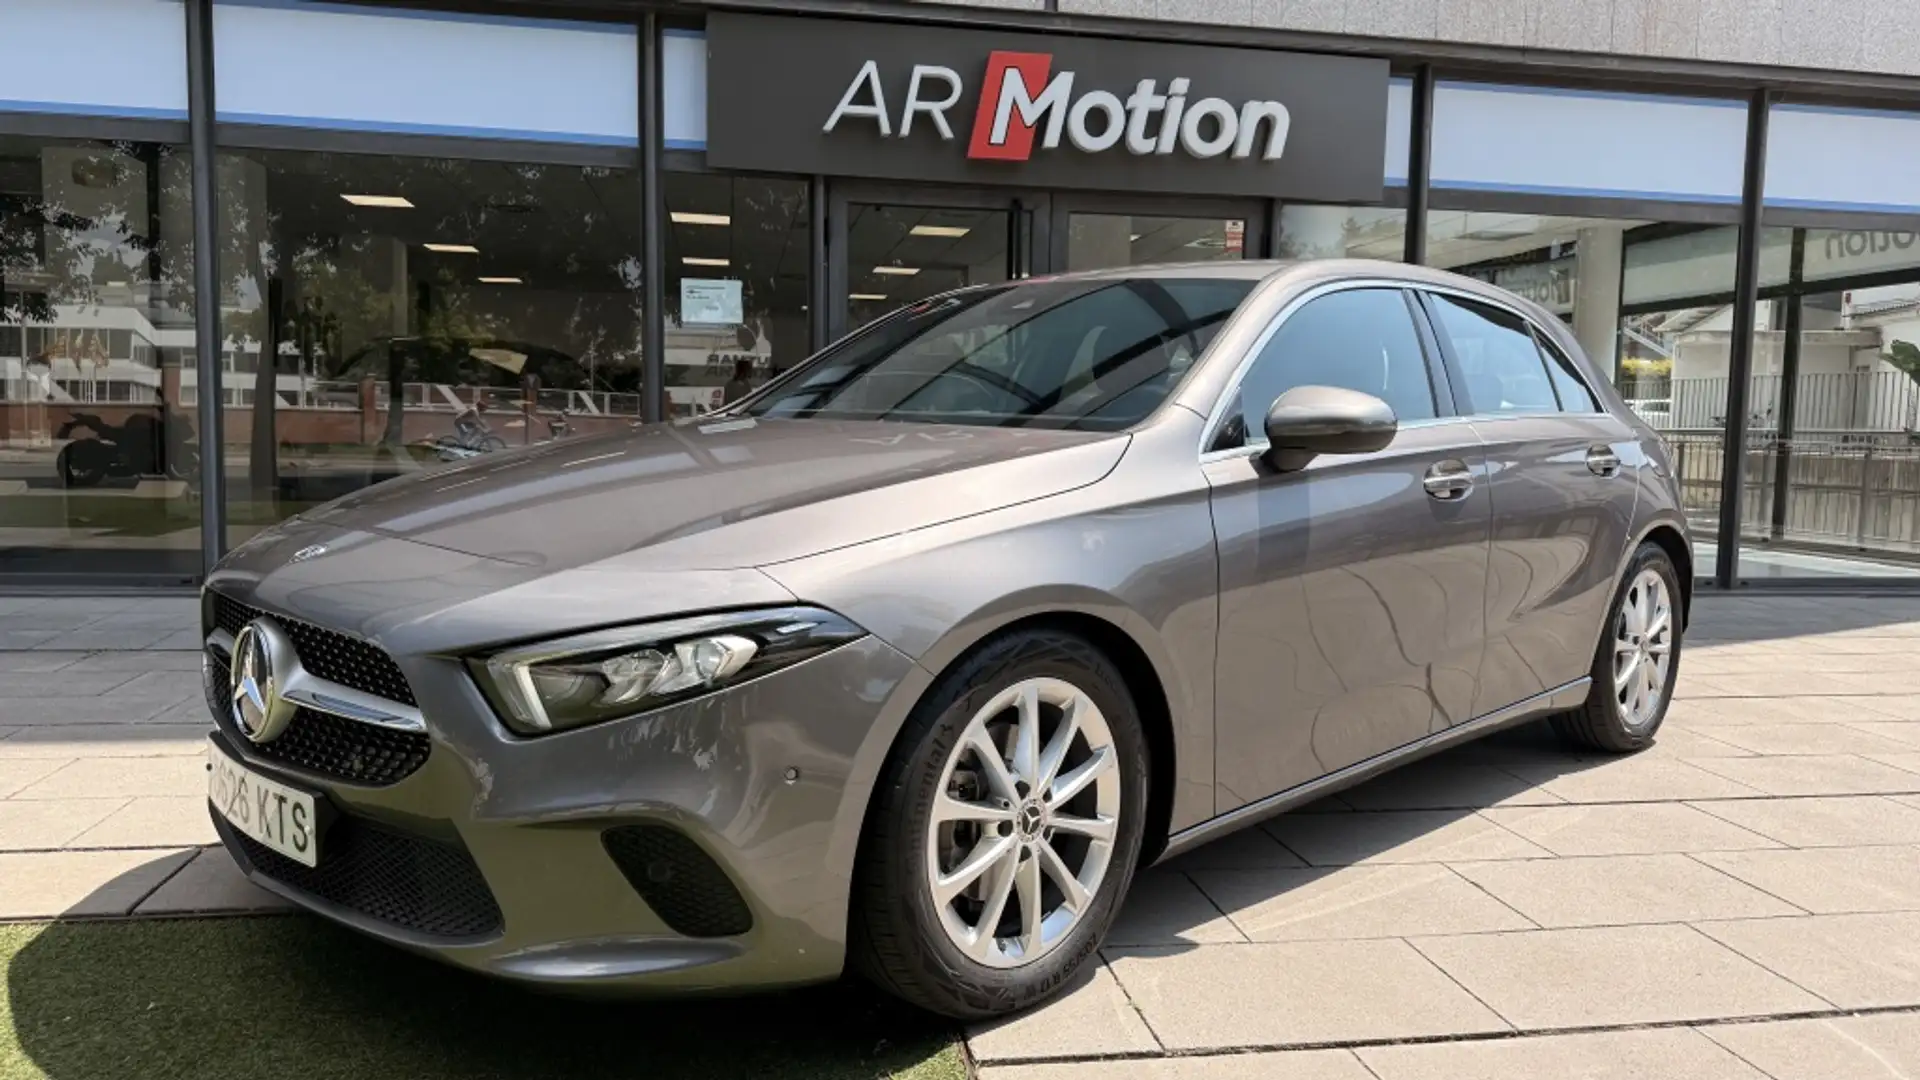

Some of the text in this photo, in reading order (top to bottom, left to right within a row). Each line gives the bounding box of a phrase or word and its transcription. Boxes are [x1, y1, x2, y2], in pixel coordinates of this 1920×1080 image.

[822, 59, 1291, 161] AR Motion
[257, 785, 309, 852] KTS
